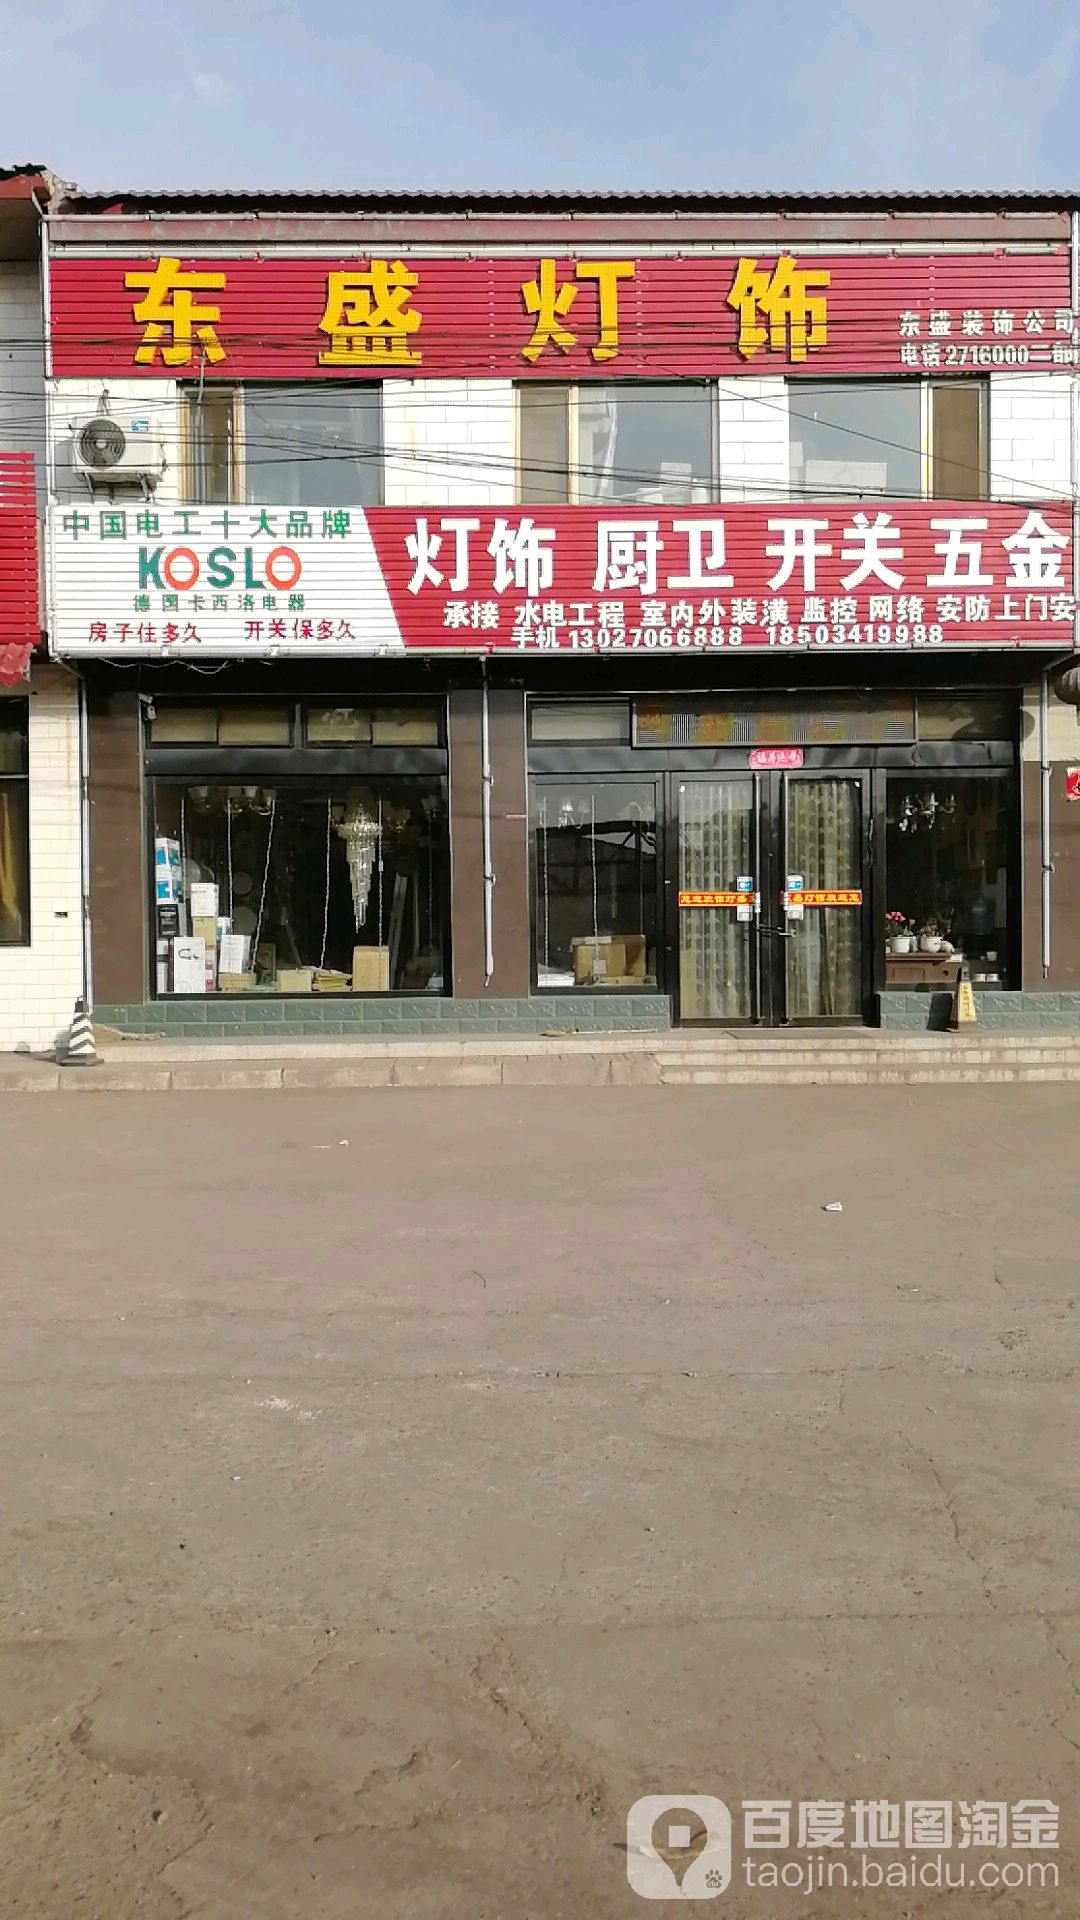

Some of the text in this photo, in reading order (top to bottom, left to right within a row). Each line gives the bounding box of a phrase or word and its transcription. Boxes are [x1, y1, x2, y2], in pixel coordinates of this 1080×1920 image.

[125, 257, 832, 366] 东盛灯饰
[899, 309, 1075, 337] 东盛装饰公司
[62, 508, 352, 541] 中国电工十大品牌
[138, 546, 302, 591] KOSLO
[404, 511, 1070, 596] 灯饰 厨卫 开关 五金
[132, 593, 306, 613] 德国卡西洛电器
[443, 599, 500, 630] 承接
[515, 599, 625, 629] 水电工程
[640, 597, 789, 628] 室内外装潢
[801, 596, 857, 624] 监控
[869, 595, 925, 624] 网络
[88, 618, 356, 644] 房子住多久 开关保多久
[511, 624, 944, 649] 手机 13027066888 18503419988
